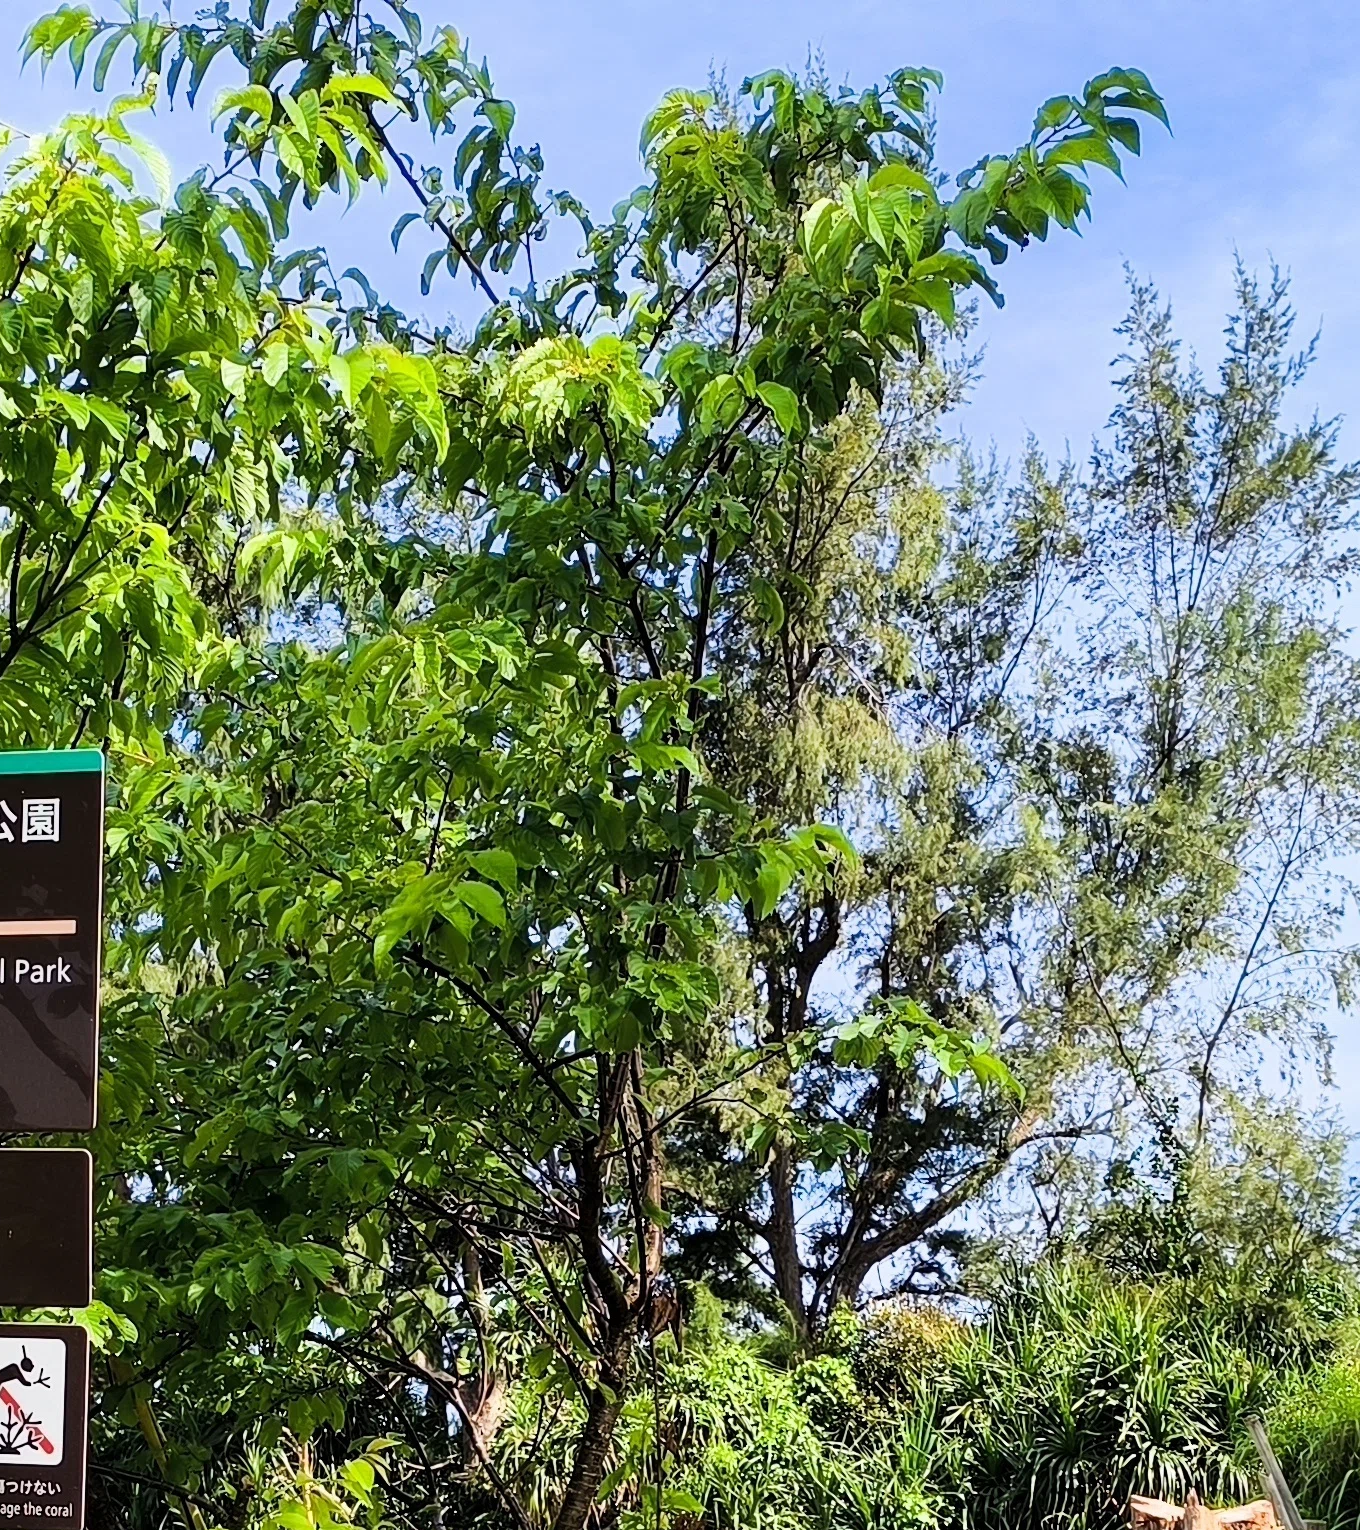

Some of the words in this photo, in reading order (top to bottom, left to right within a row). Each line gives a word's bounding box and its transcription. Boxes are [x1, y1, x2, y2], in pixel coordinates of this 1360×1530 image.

[15, 957, 72, 984] Park
[23, 1501, 42, 1516] the
[44, 1502, 73, 1518] coral
